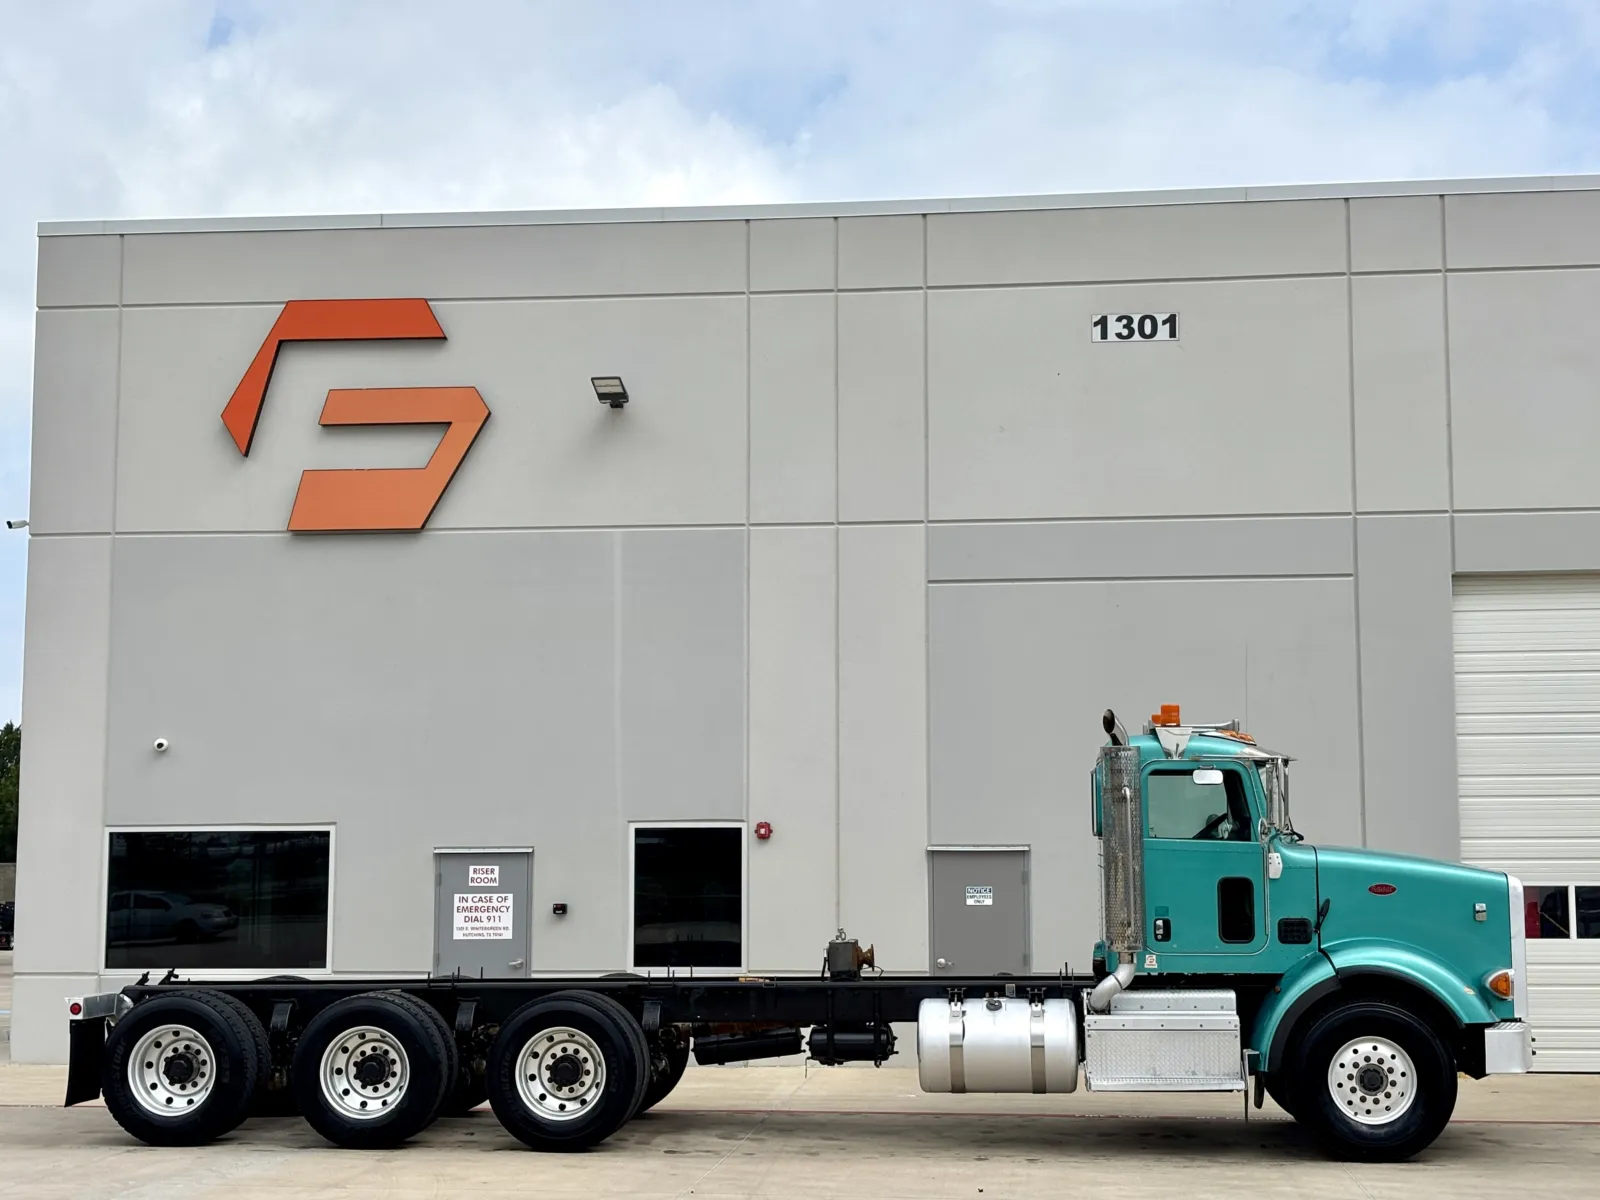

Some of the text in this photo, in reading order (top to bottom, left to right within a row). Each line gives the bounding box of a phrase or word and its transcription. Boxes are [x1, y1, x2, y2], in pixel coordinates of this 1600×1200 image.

[1093, 313, 1177, 340] 1301
[472, 867, 496, 875] RISER
[470, 876, 497, 884] ROOM
[456, 905, 511, 913] EMERGENCY
[464, 915, 502, 923] DIAL 911
